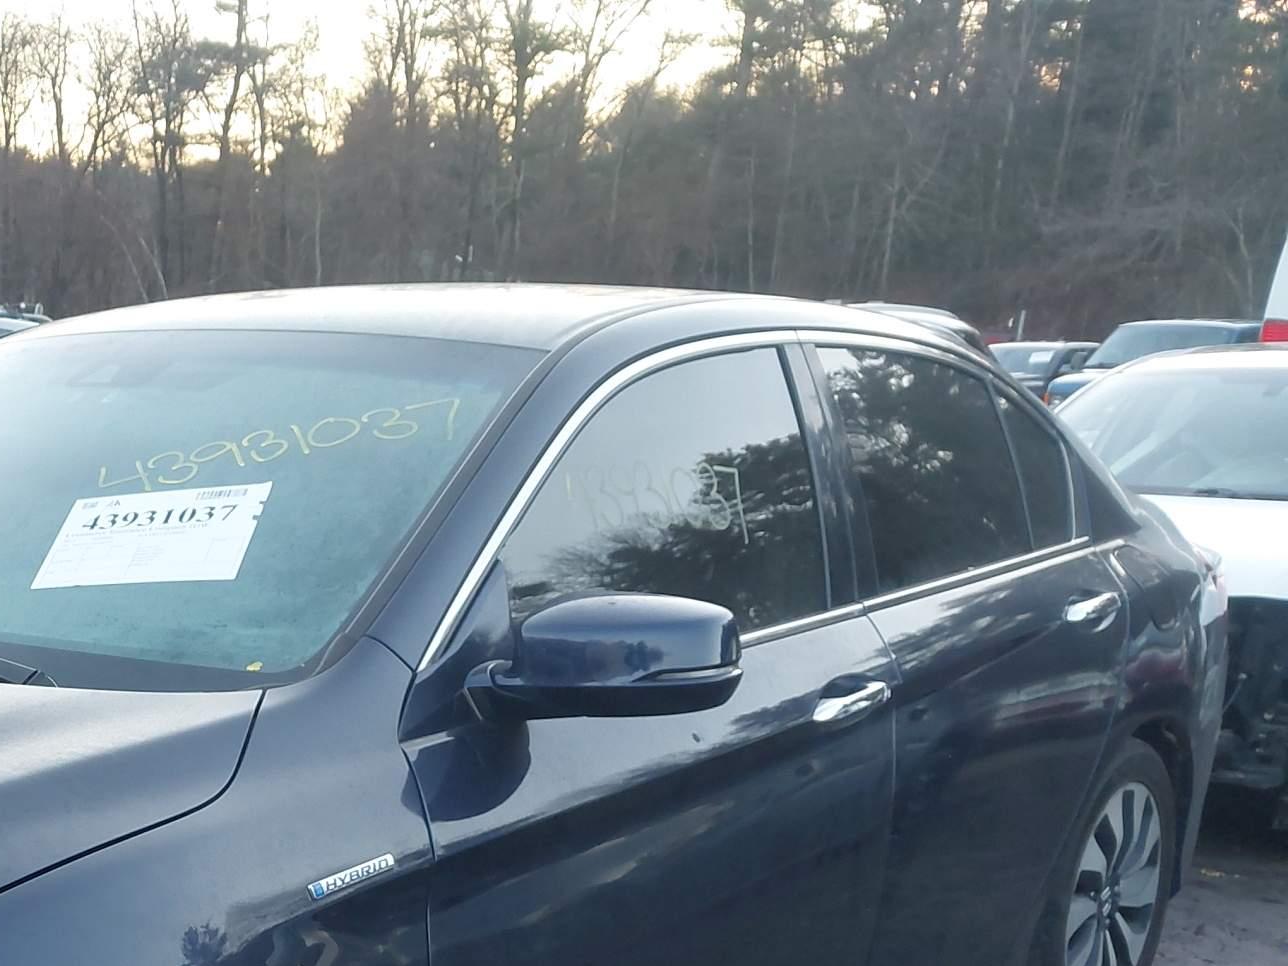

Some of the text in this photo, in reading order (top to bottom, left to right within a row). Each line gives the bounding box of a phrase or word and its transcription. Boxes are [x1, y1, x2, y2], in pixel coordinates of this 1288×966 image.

[97, 396, 461, 491] 43931037
[82, 503, 239, 531] 43931037
[325, 857, 390, 892] HYBRID
